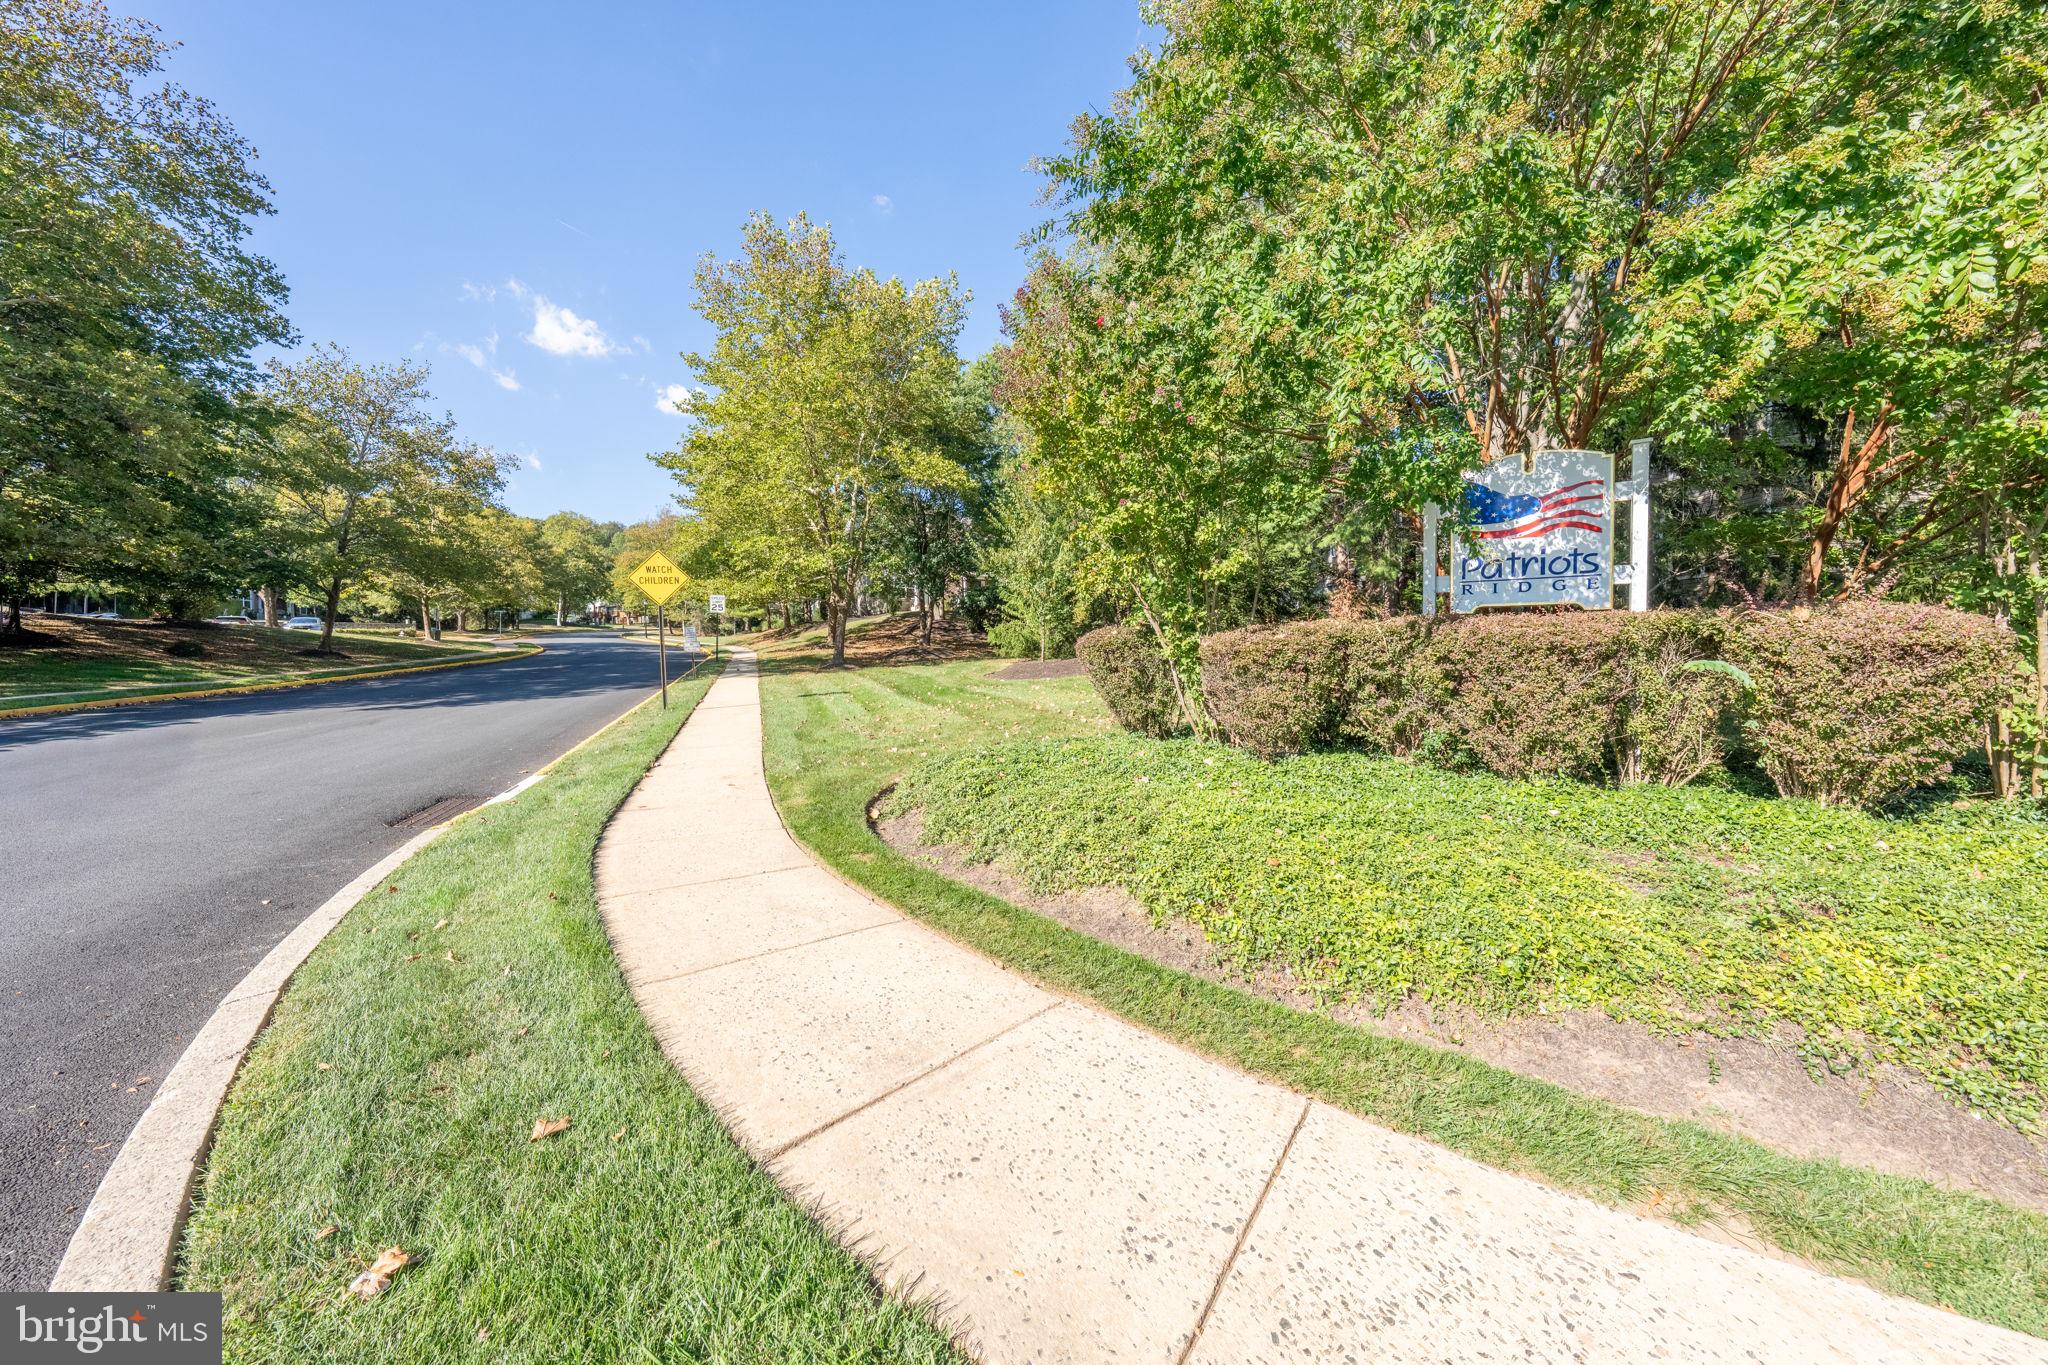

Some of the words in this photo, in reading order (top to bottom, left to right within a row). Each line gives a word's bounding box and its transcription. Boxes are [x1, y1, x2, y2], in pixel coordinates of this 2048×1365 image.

[1461, 548, 1600, 580] Patriots
[645, 565, 673, 574] WATCH
[638, 576, 680, 585] CHILDREN
[1461, 577, 1600, 595] RIDGE
[711, 603, 724, 611] 25
